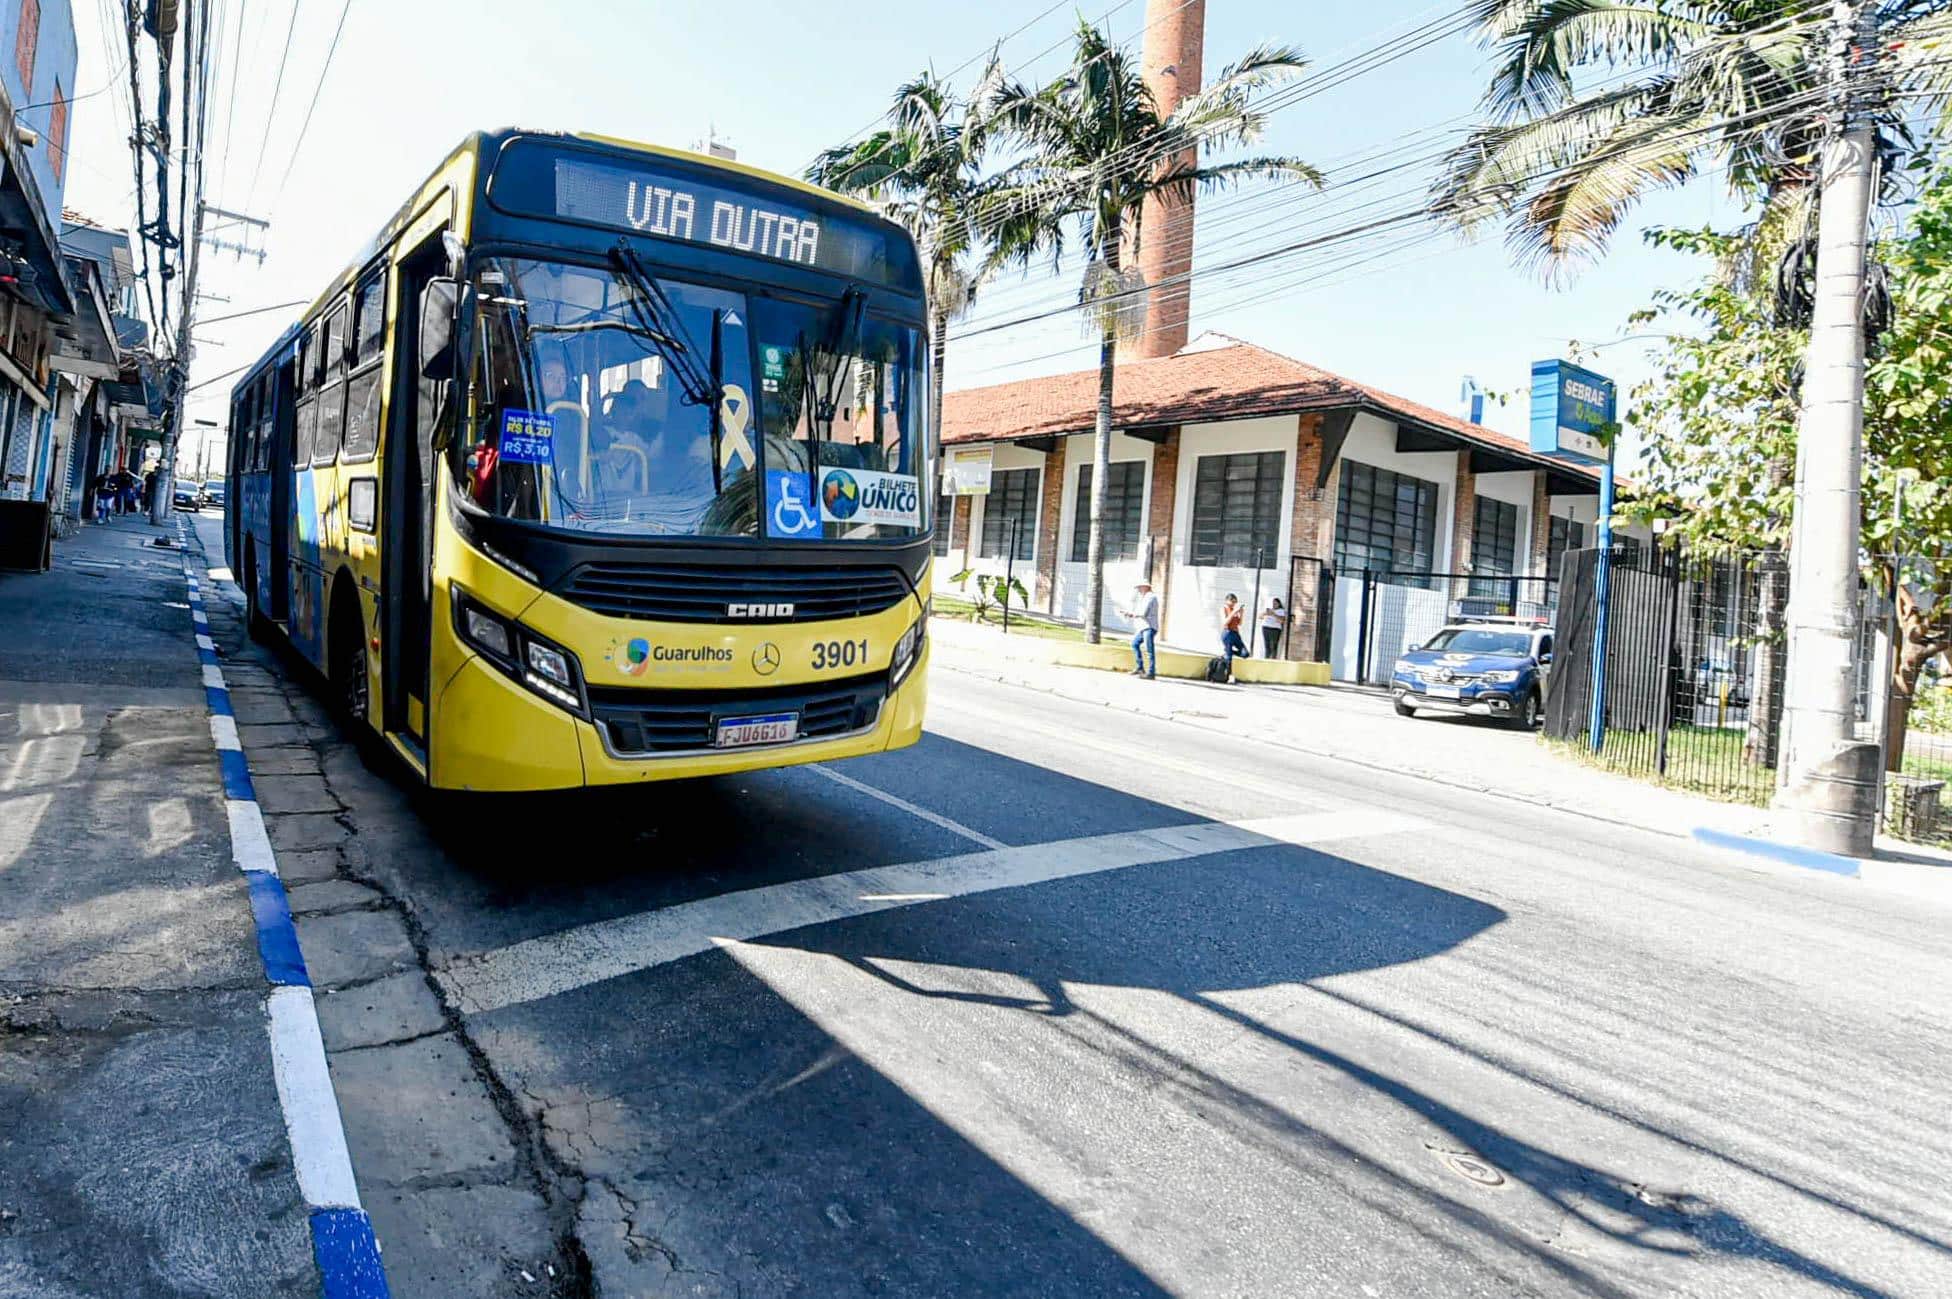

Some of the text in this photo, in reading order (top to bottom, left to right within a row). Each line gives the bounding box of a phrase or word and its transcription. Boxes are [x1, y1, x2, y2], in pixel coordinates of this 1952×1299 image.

[627, 181, 820, 265] VIA DUTRA
[1564, 379, 1606, 407] SEBRAE
[506, 422, 523, 434] R$
[504, 441, 550, 457] R$ 3,10
[879, 478, 916, 492] BILHETE
[862, 483, 917, 512] ÚNICO
[728, 603, 794, 617] CAIO
[653, 645, 733, 661] Guarulhos
[811, 639, 867, 669] 3901
